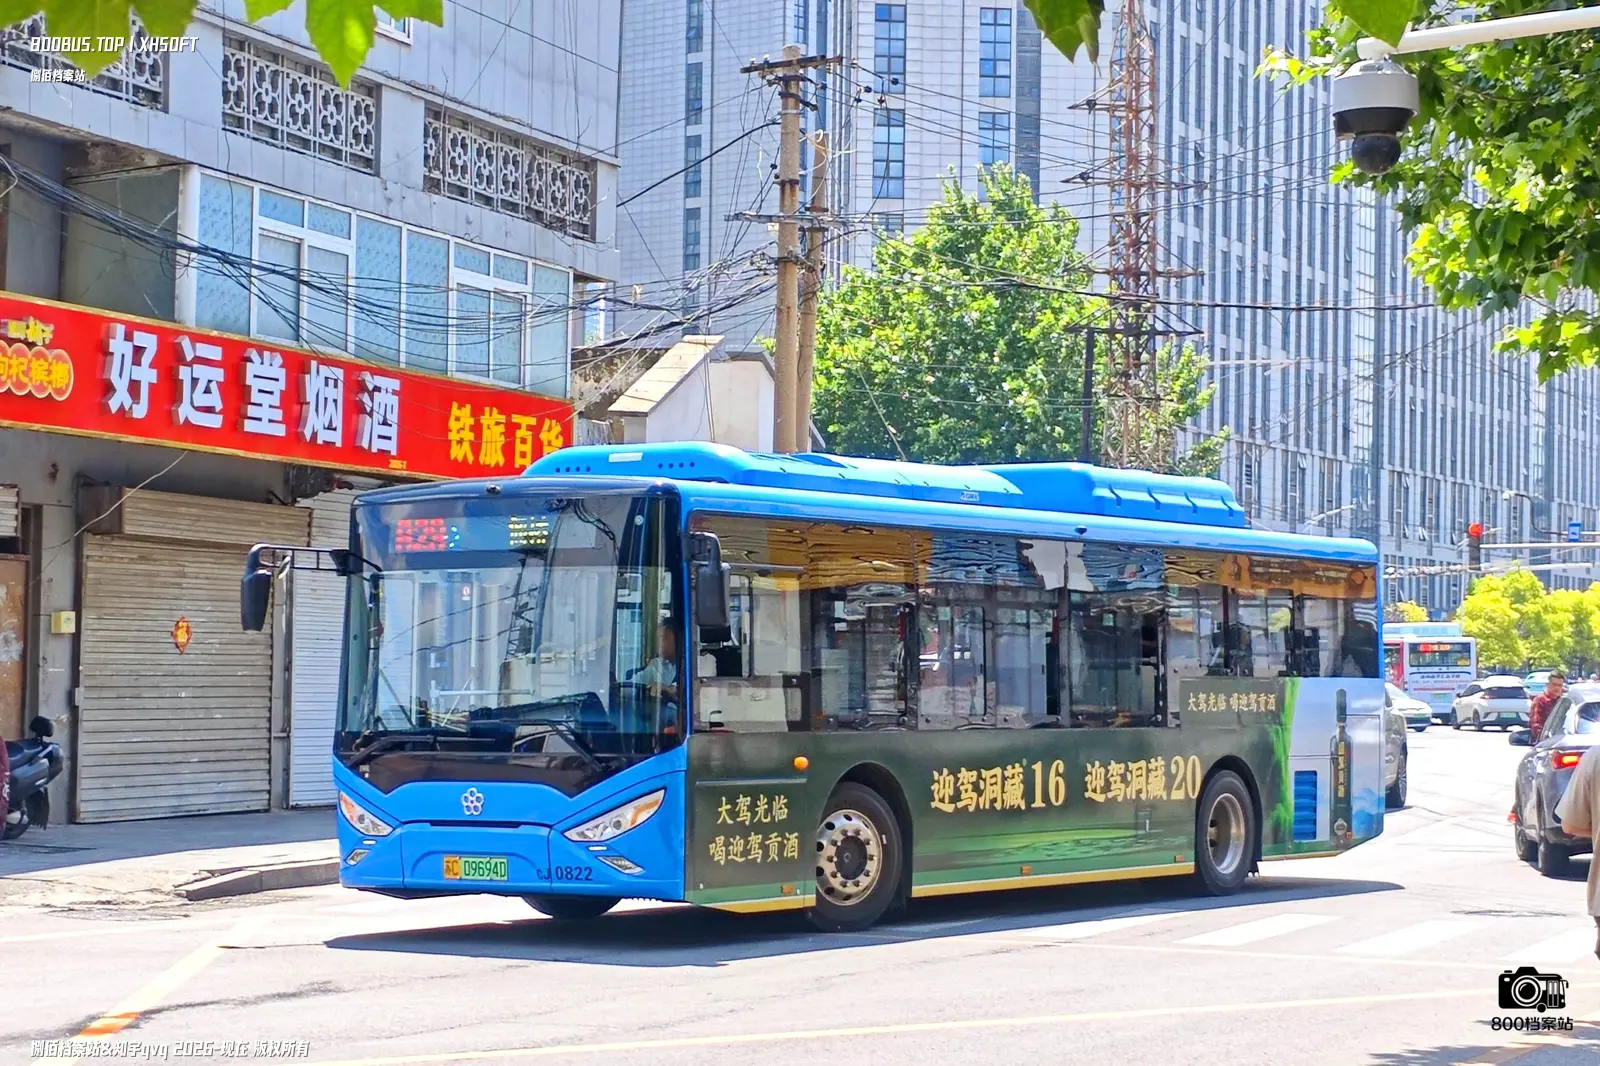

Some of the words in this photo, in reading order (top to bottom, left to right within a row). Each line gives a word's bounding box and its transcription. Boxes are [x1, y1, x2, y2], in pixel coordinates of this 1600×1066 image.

[107, 323, 400, 456] 好运堂烟酒
[1187, 692, 1226, 713] 大驾光临
[716, 793, 788, 826] 大驾光临
[708, 832, 799, 866] 喝迎驾贡酒
[555, 865, 593, 881] 0822
